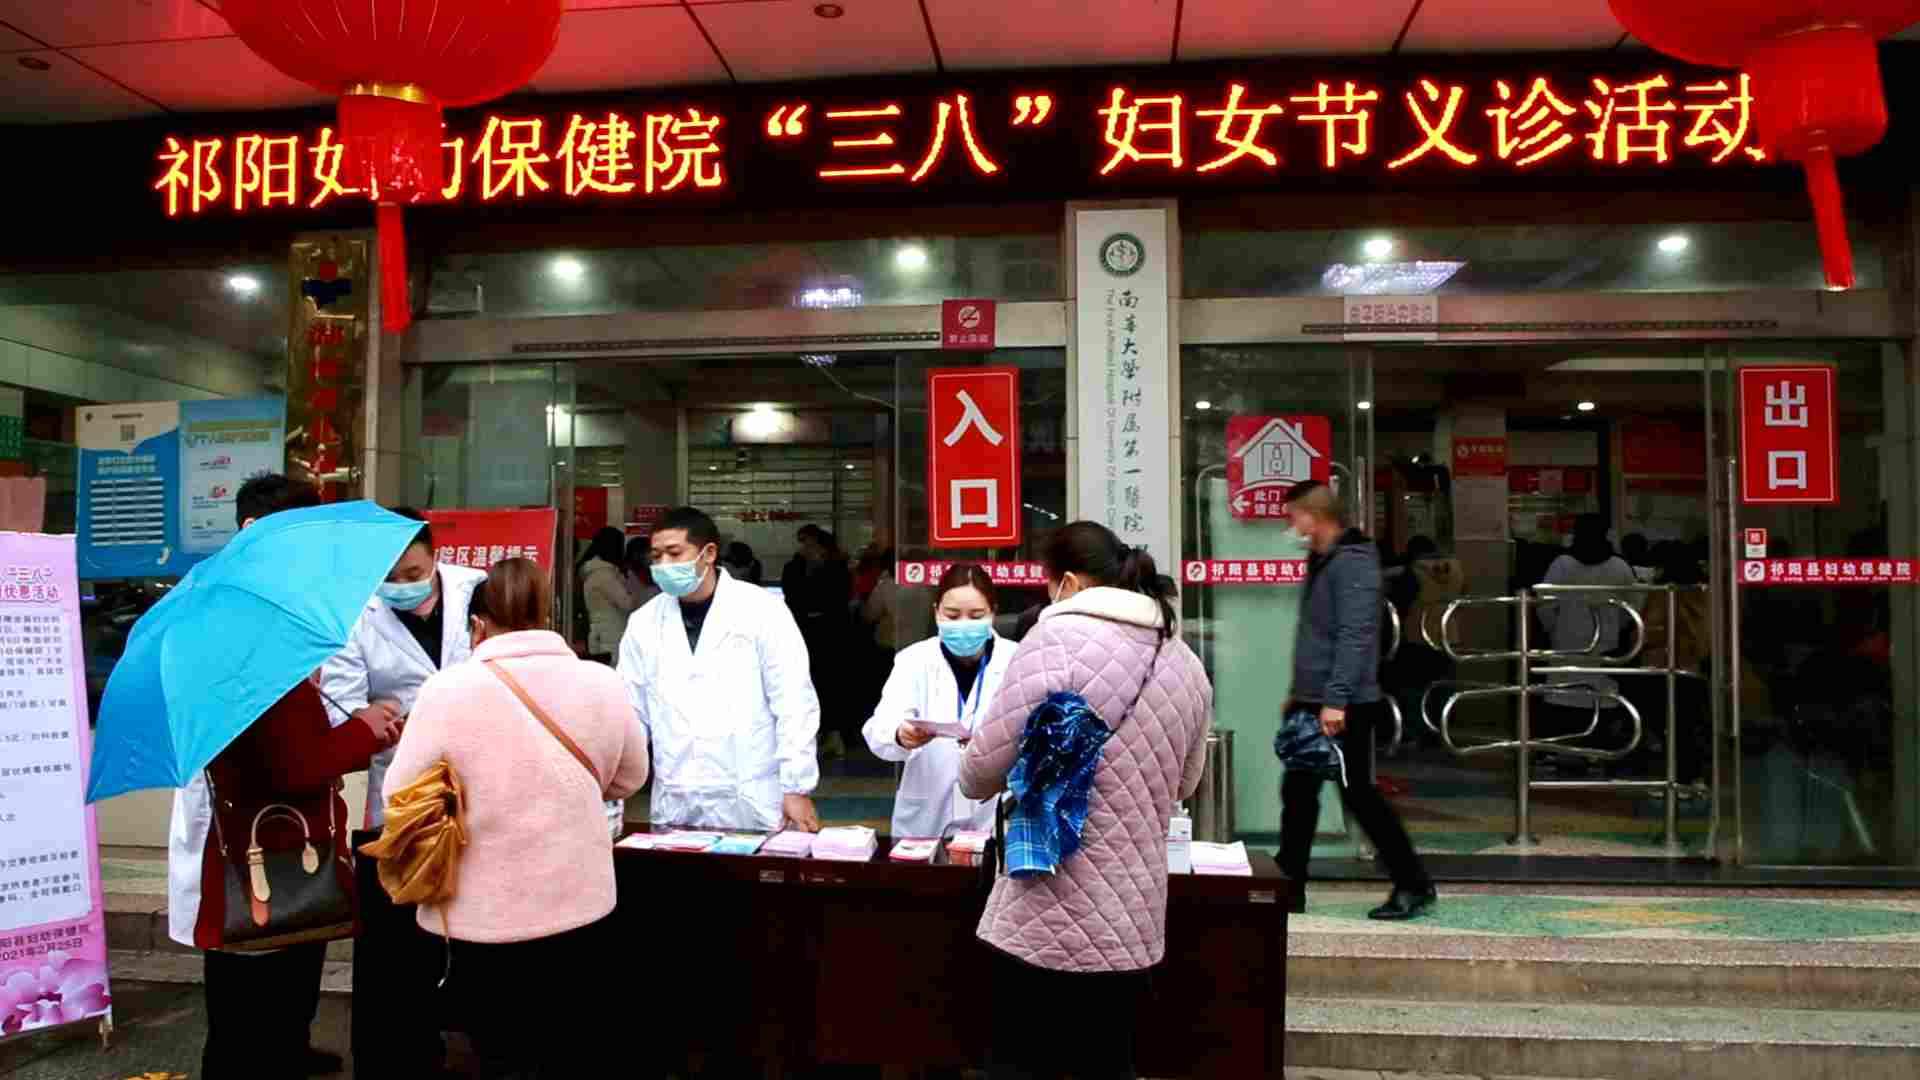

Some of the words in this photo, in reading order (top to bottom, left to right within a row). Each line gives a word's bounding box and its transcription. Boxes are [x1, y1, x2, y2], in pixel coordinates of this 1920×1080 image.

[943, 389, 1004, 529] 入口
[1764, 380, 1808, 490] 出口
[1770, 561, 1911, 576] 祁阳县妇幼保健院
